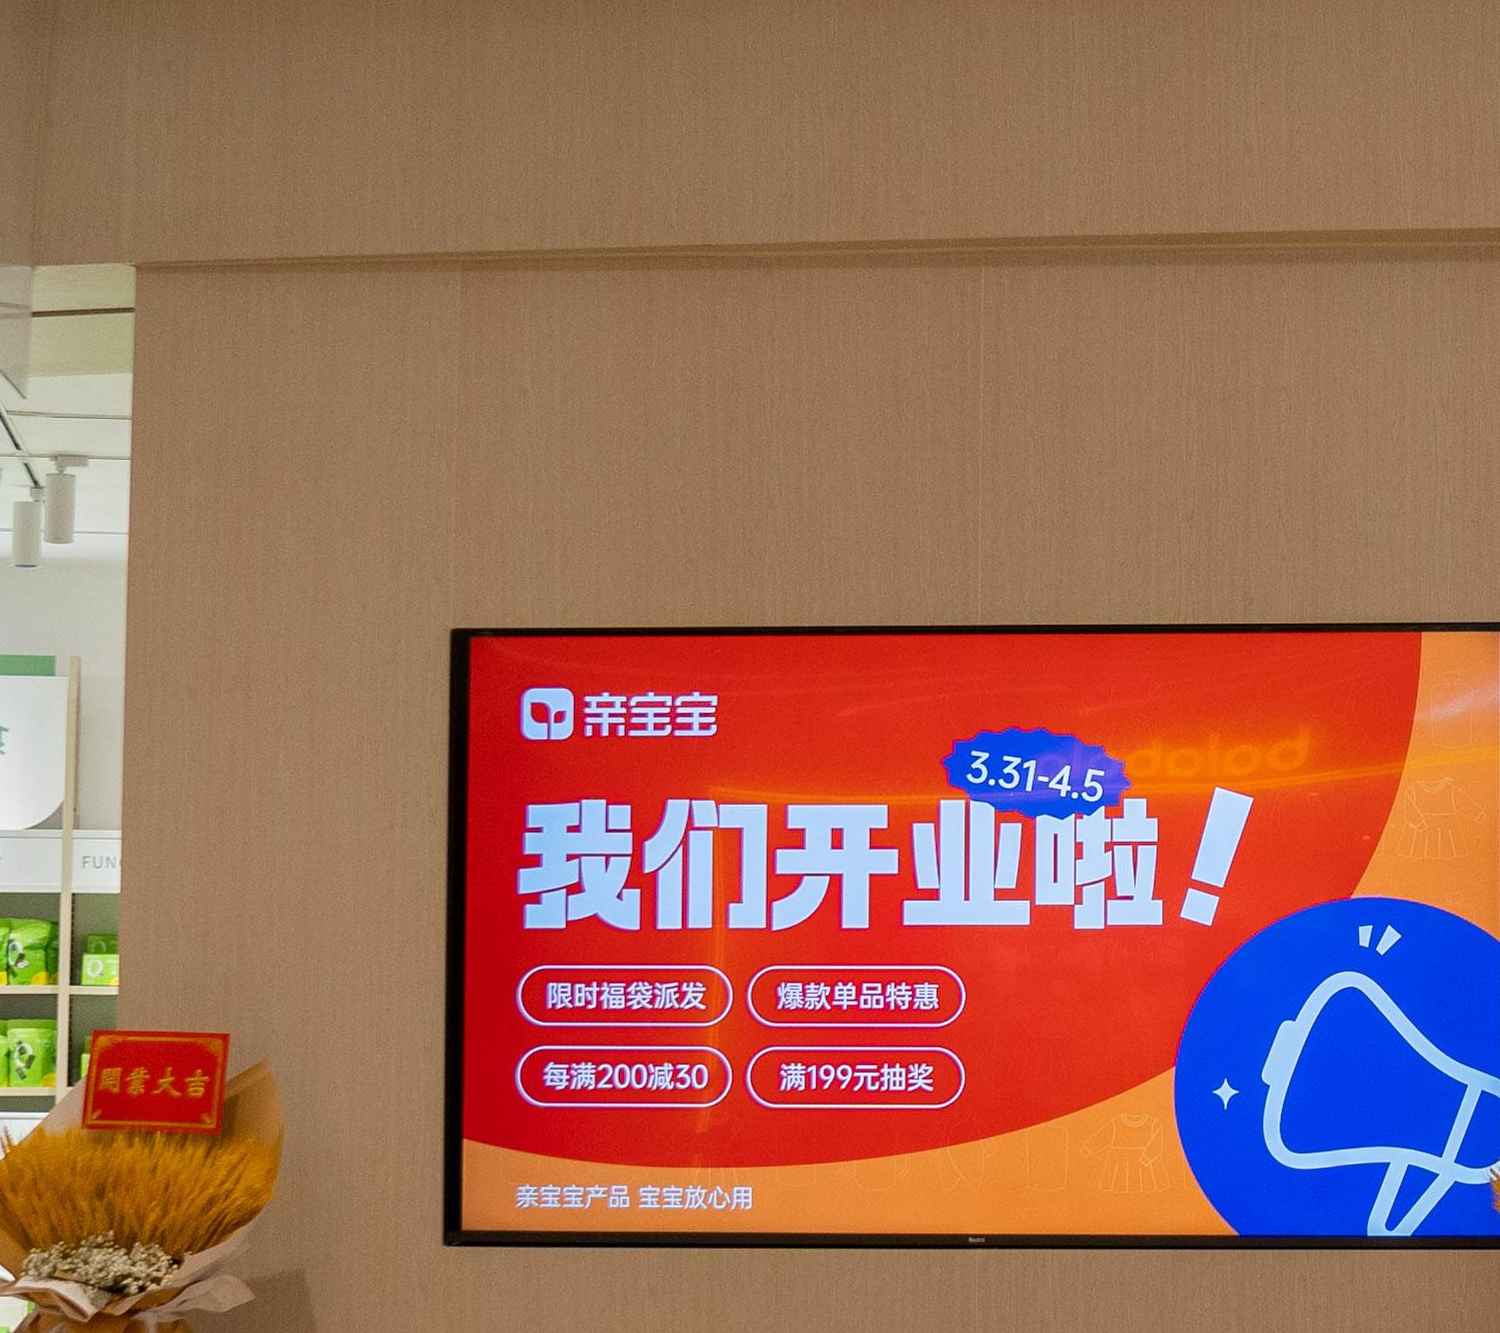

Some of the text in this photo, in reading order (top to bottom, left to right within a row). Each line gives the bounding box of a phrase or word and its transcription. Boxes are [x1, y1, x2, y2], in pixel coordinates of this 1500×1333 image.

[583, 690, 719, 738] 亲宝宝
[965, 749, 1106, 803] 3.31-4.5
[81, 855, 123, 870] FUN
[546, 981, 708, 1011] 限时福袋派发
[776, 981, 940, 1011] 爆款单品特惠
[543, 1061, 710, 1092] 每满200减30
[779, 1063, 935, 1093] 满199元抽奖
[516, 1184, 754, 1210] 亲宝宝产品 宝宝放心用
